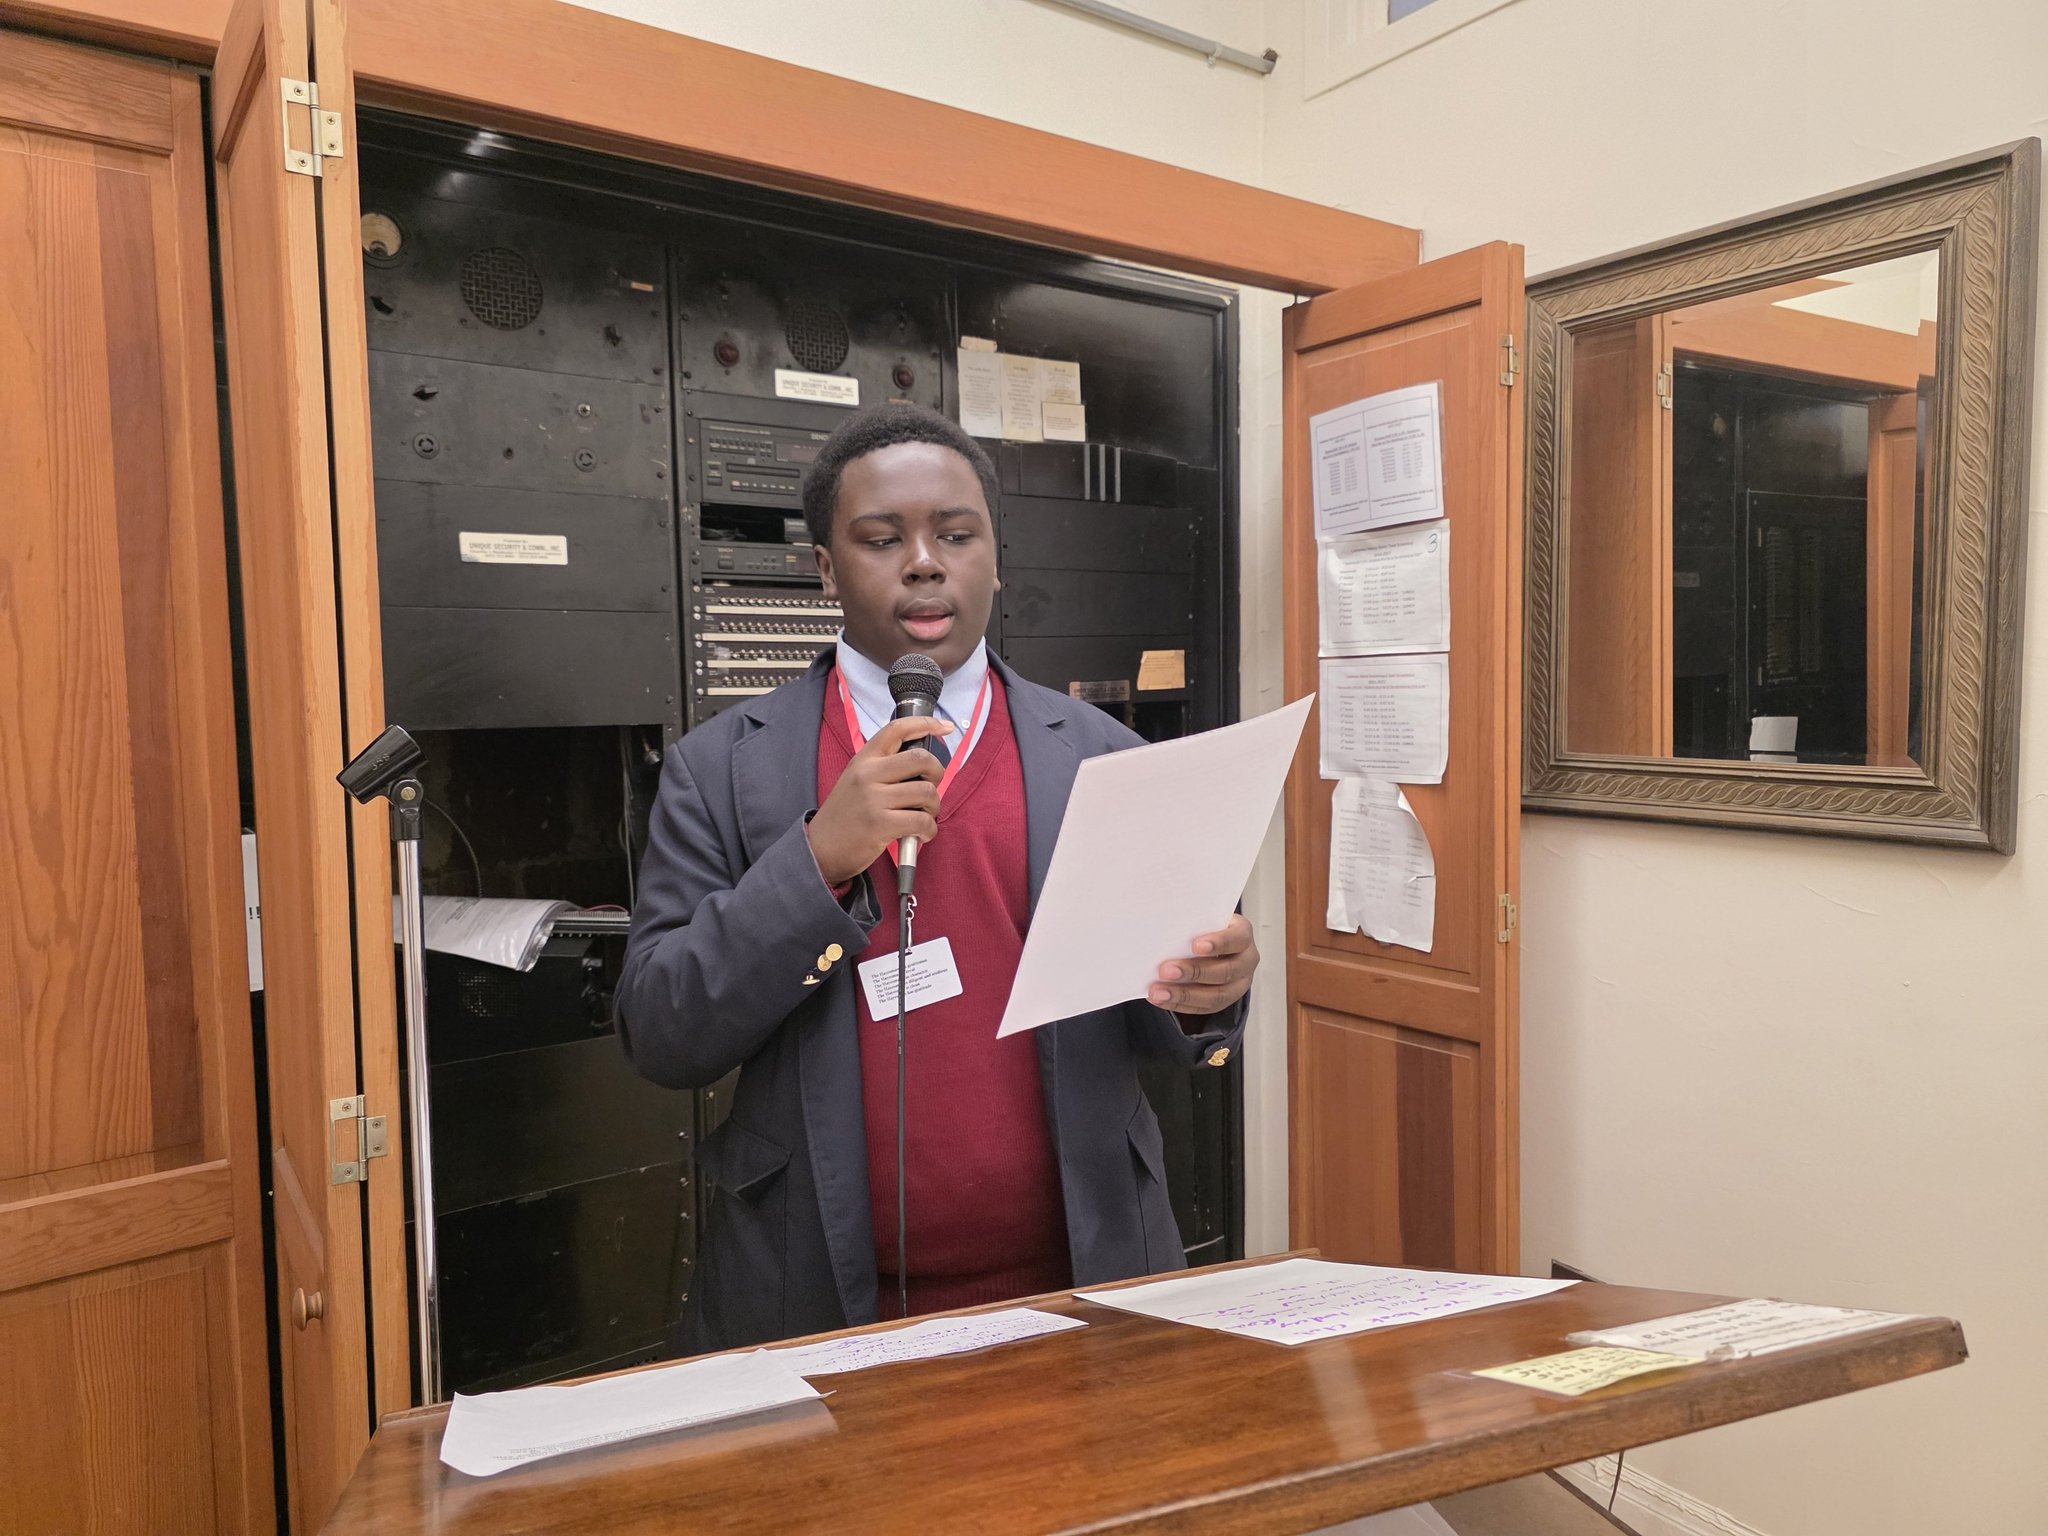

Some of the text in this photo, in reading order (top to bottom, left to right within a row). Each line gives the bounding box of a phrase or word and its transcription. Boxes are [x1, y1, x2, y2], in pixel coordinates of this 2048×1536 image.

[469, 542, 491, 550] UNIQUE
[494, 543, 520, 551] SECURITY
[1427, 533, 1438, 553] 3
